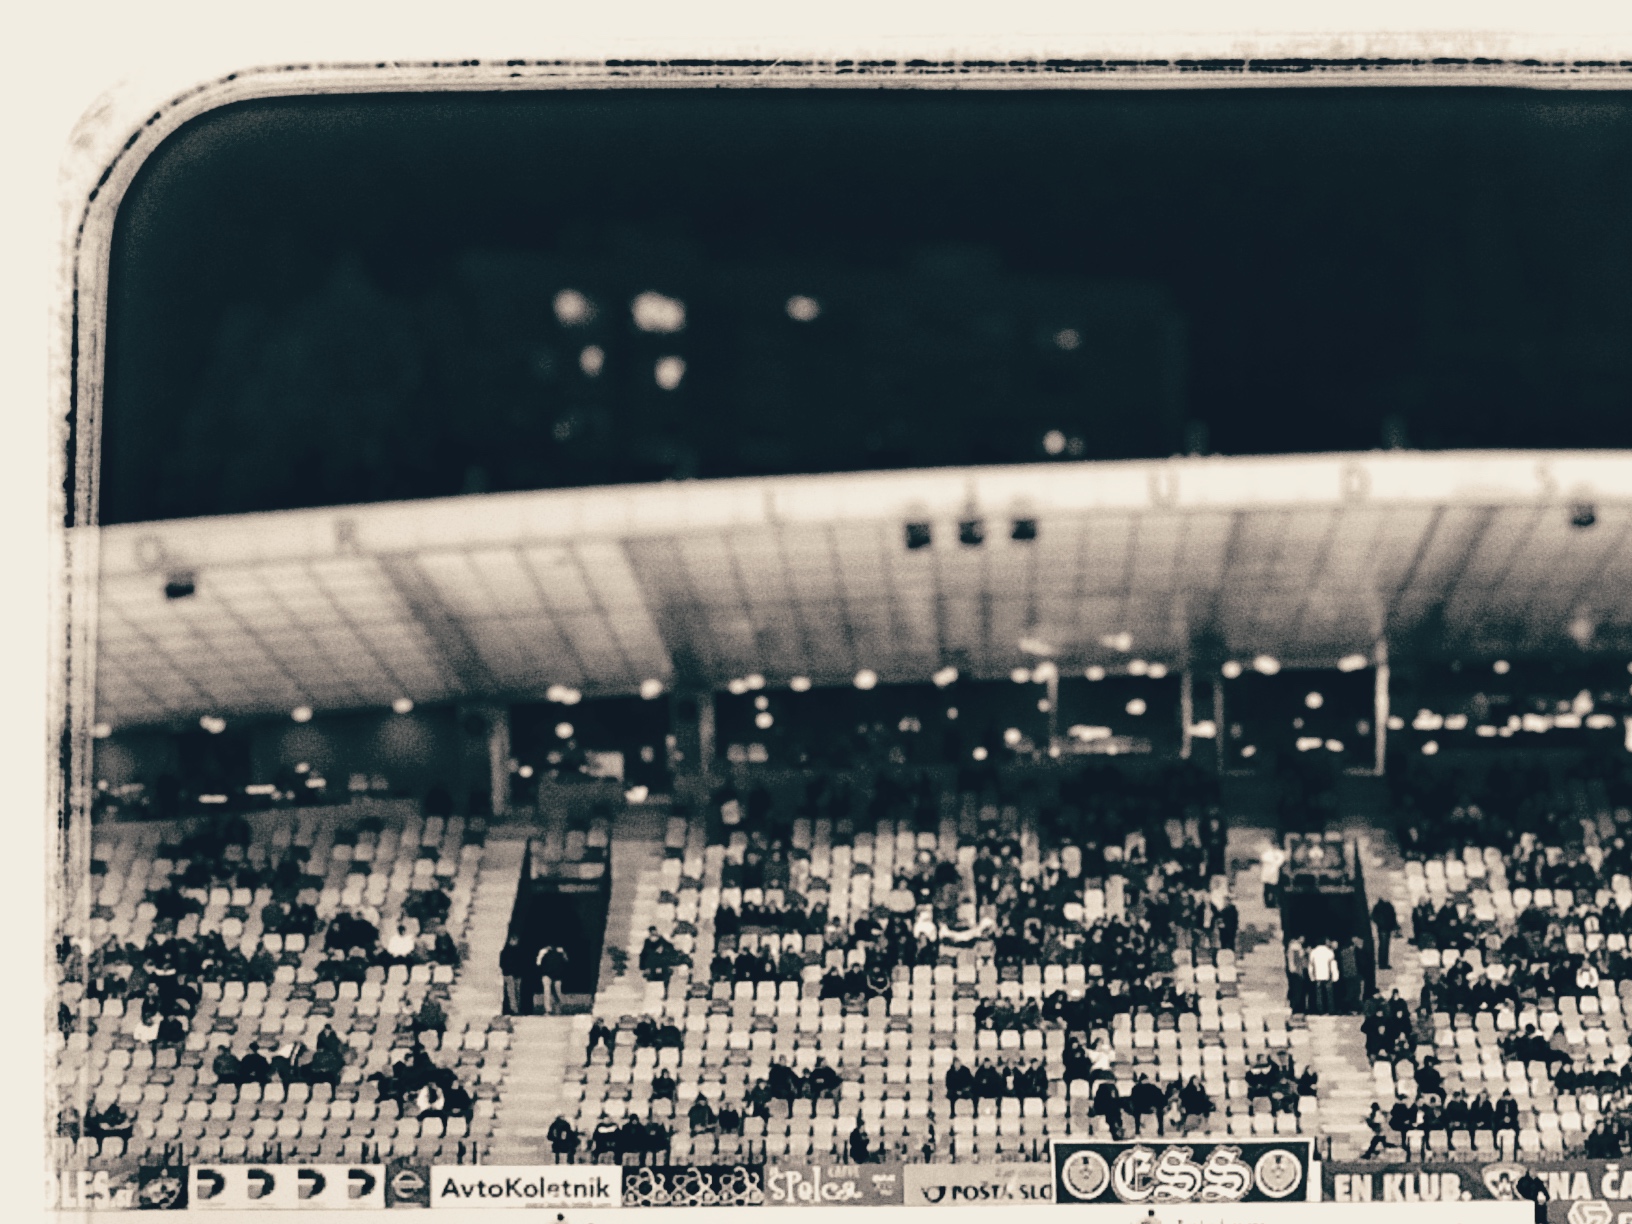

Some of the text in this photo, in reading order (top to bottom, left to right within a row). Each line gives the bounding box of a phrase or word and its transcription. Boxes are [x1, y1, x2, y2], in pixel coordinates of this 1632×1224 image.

[440, 1176, 611, 1199] AvtoKoletnik
[1334, 1172, 1473, 1202] EN KLUB.
